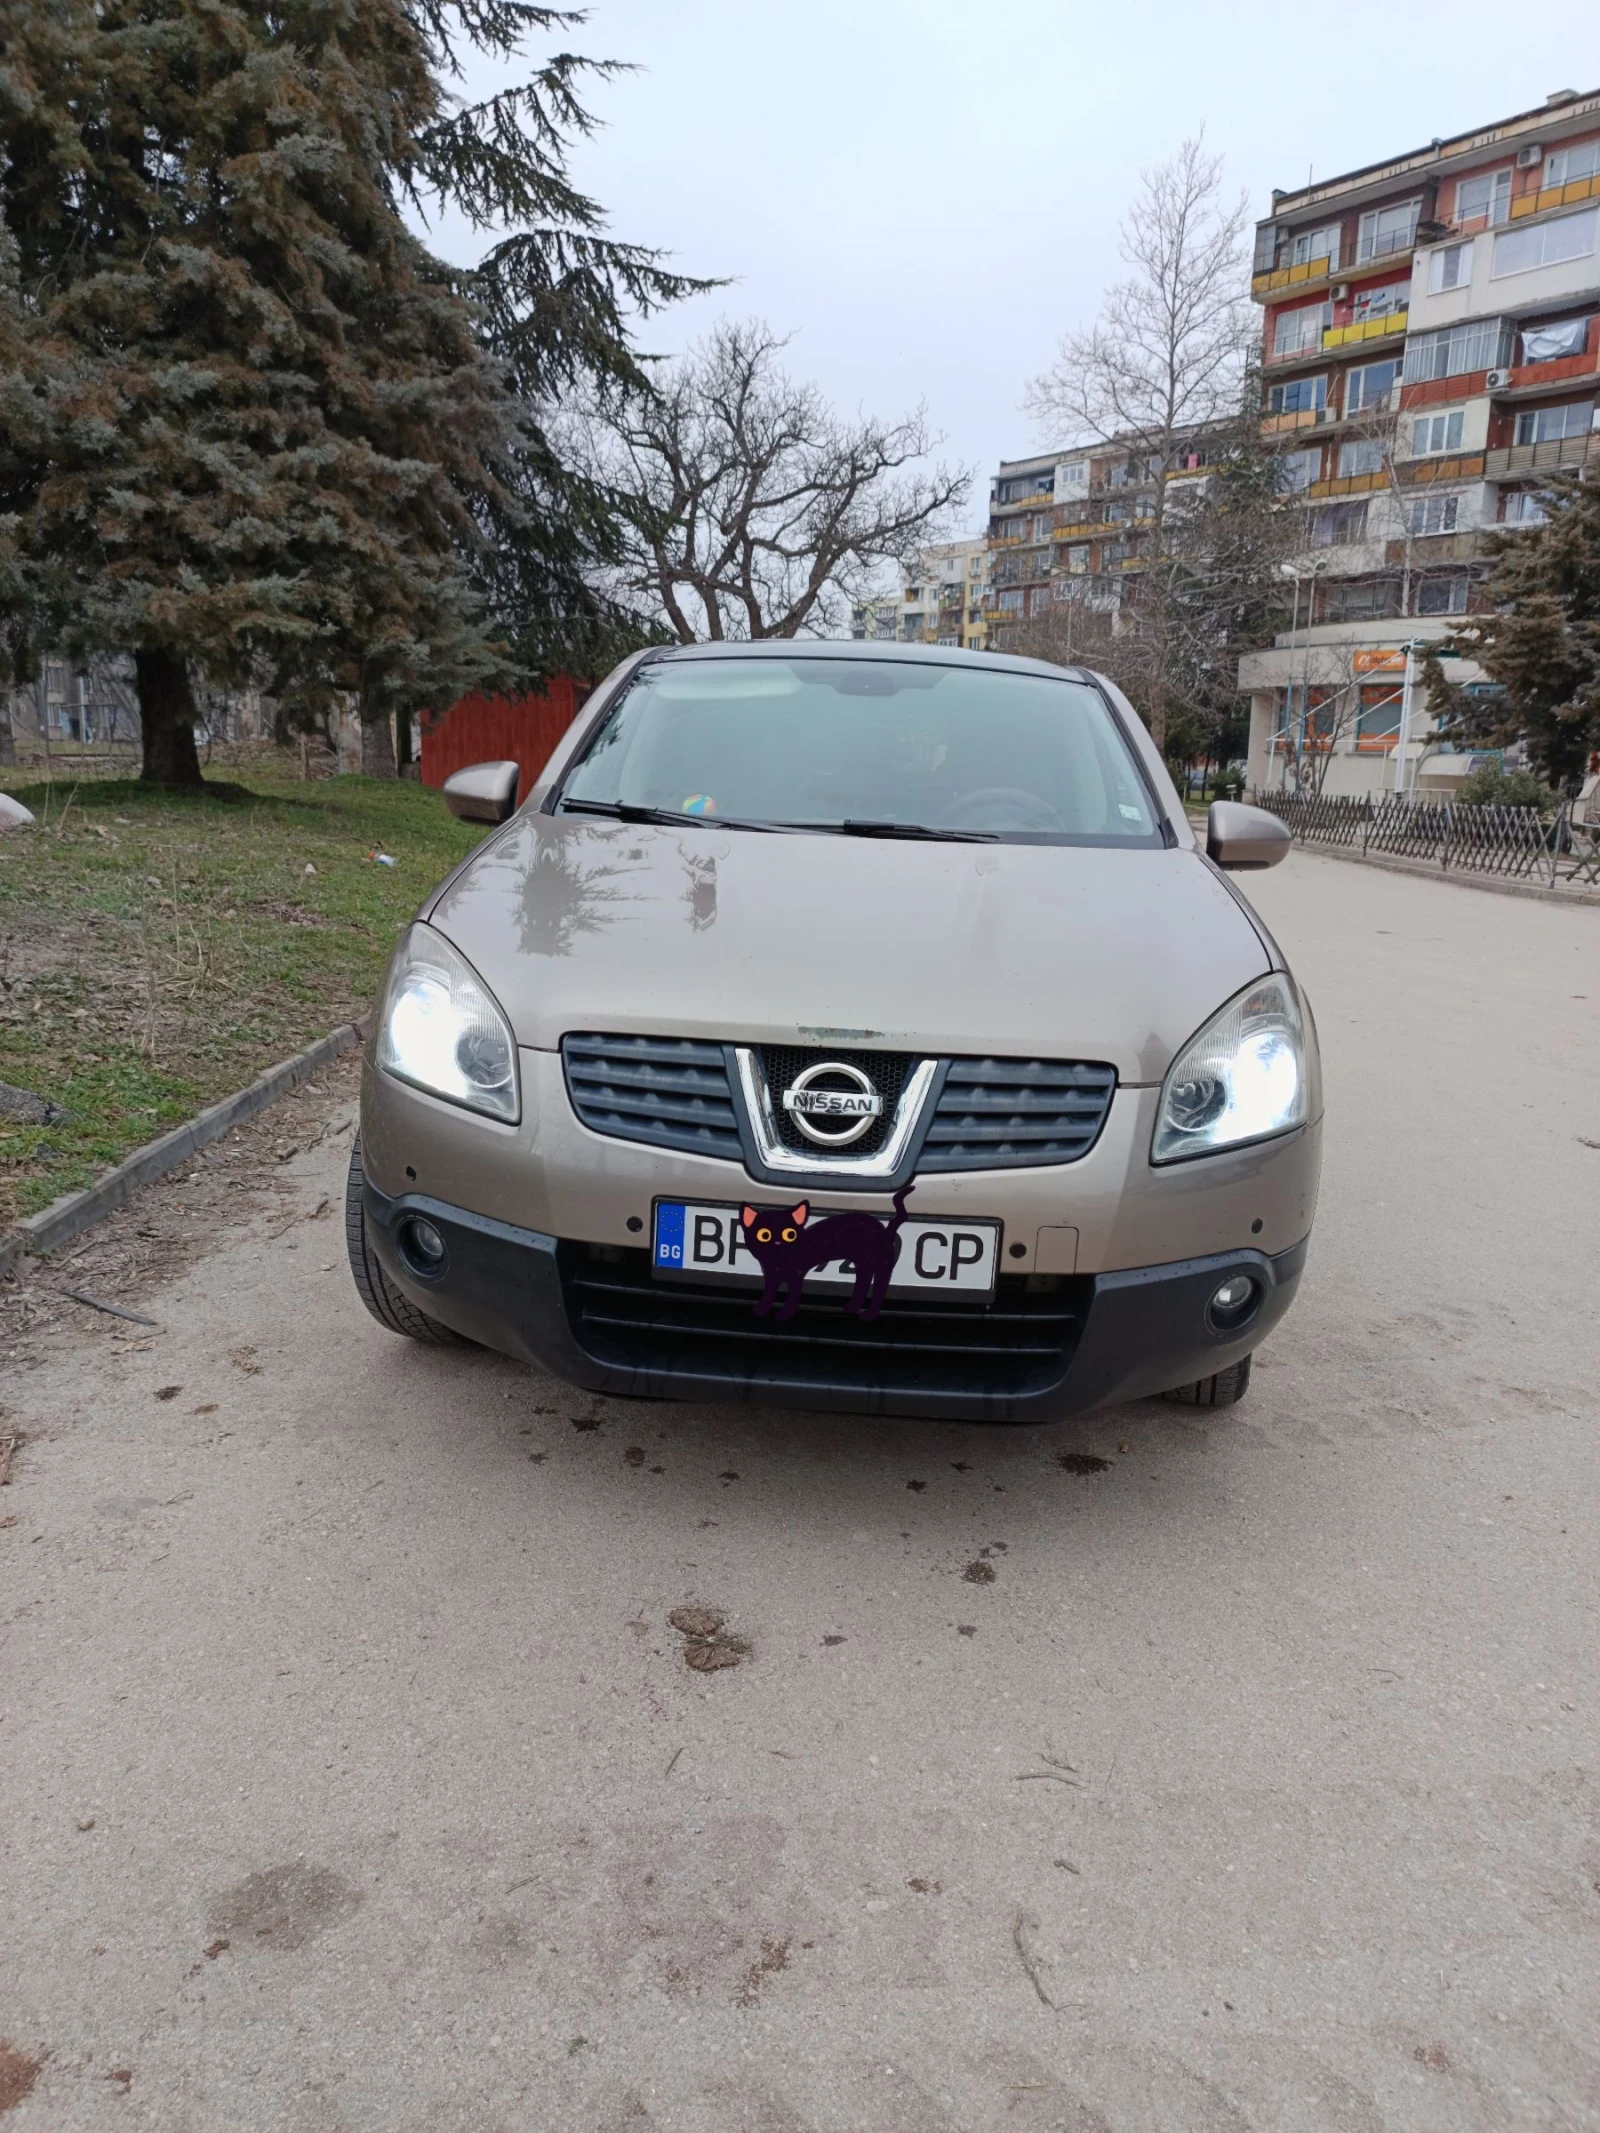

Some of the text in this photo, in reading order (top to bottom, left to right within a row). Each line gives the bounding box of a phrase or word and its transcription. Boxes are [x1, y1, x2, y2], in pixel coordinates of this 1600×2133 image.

[793, 1094, 873, 1112] NISSAN
[660, 1244, 681, 1259] BG
[914, 1231, 984, 1280] CP
